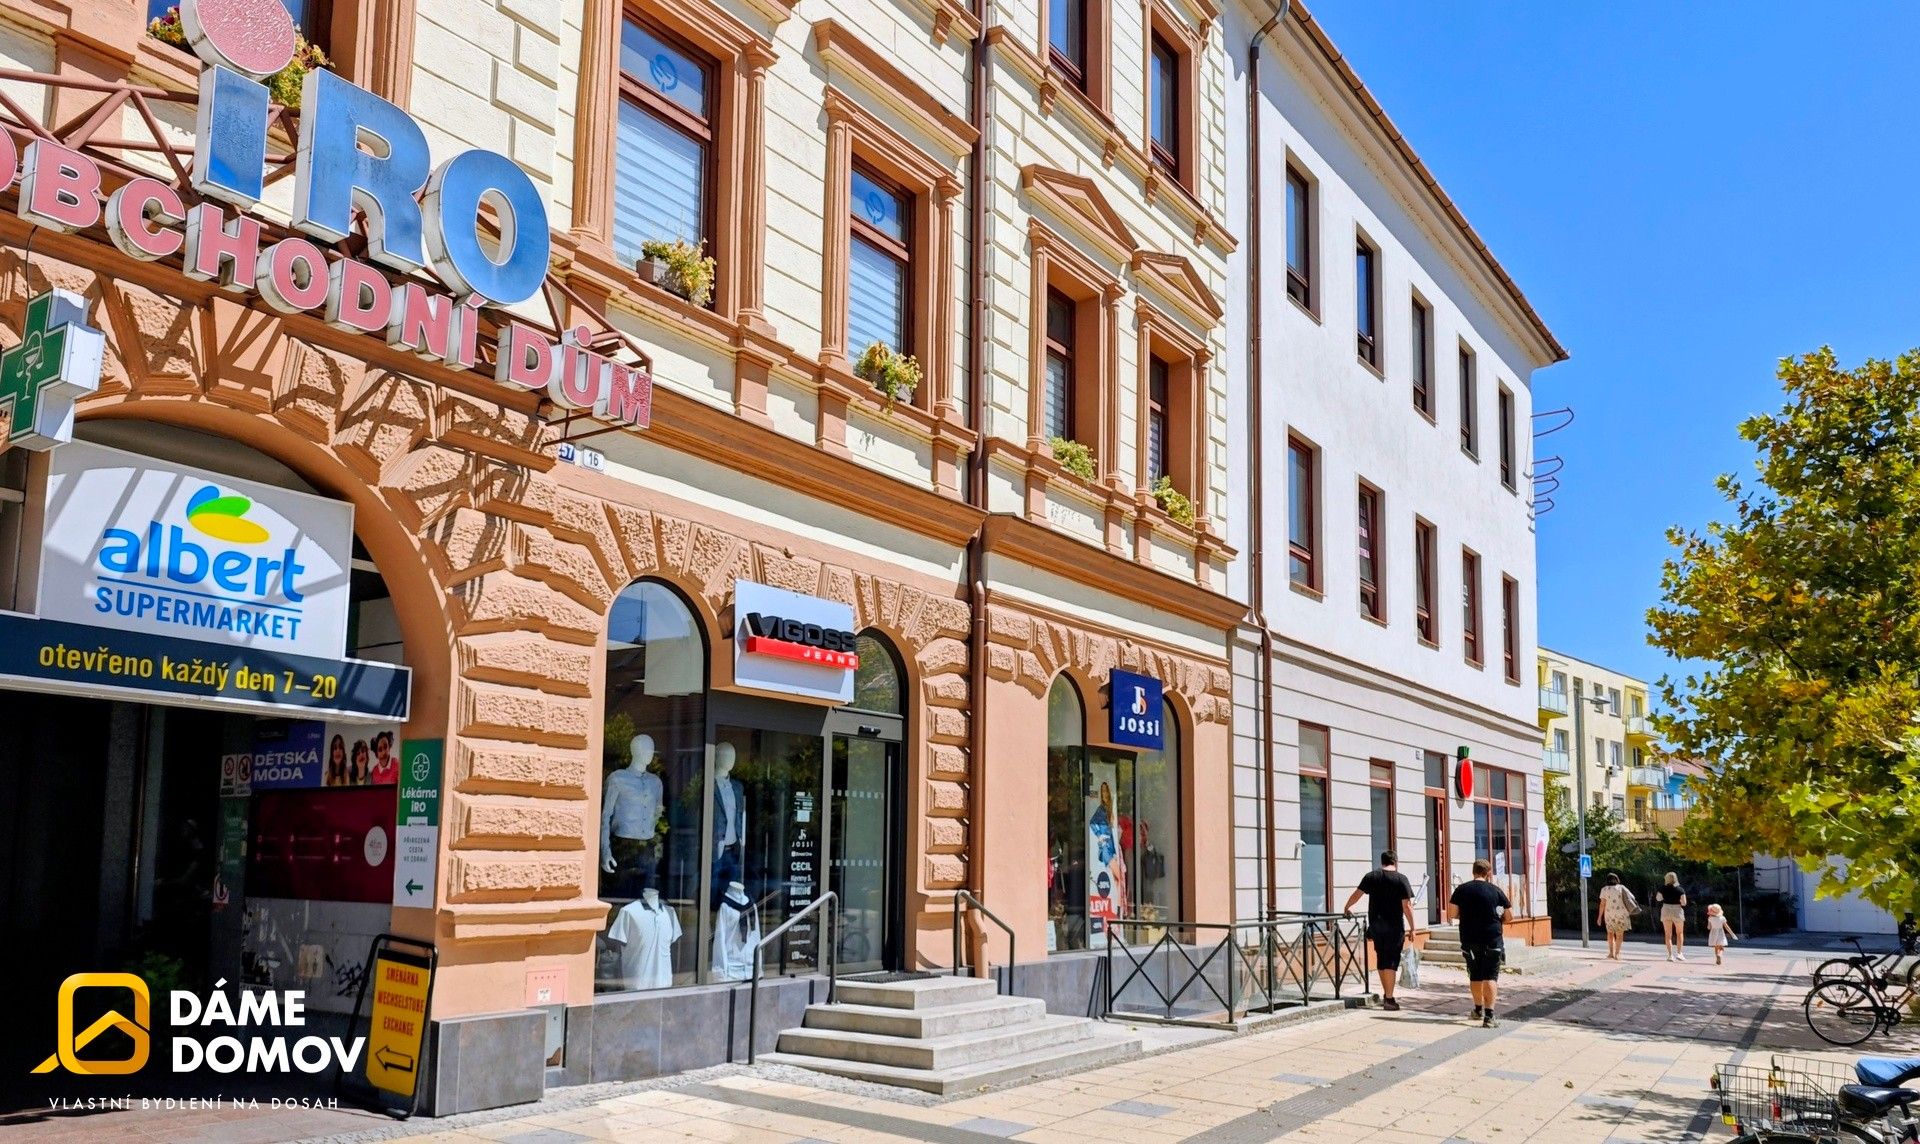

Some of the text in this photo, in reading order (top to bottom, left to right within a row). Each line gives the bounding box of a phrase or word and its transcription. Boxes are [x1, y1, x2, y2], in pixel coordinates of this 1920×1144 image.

[502, 323, 652, 429] DŮM
[559, 443, 575, 460] 57
[588, 451, 599, 467] 16
[100, 520, 305, 602] albert
[95, 586, 302, 641] SUPERMARKET
[746, 612, 857, 652] VIGOSS
[803, 649, 856, 666] JEANS
[40, 642, 153, 679] otevřeno
[162, 658, 229, 692] každý
[235, 665, 275, 692] den
[254, 747, 319, 766] DĚTSKÁ
[254, 766, 303, 782] MÓDA
[402, 786, 437, 799] Lékárna
[790, 861, 812, 871] CECIL
